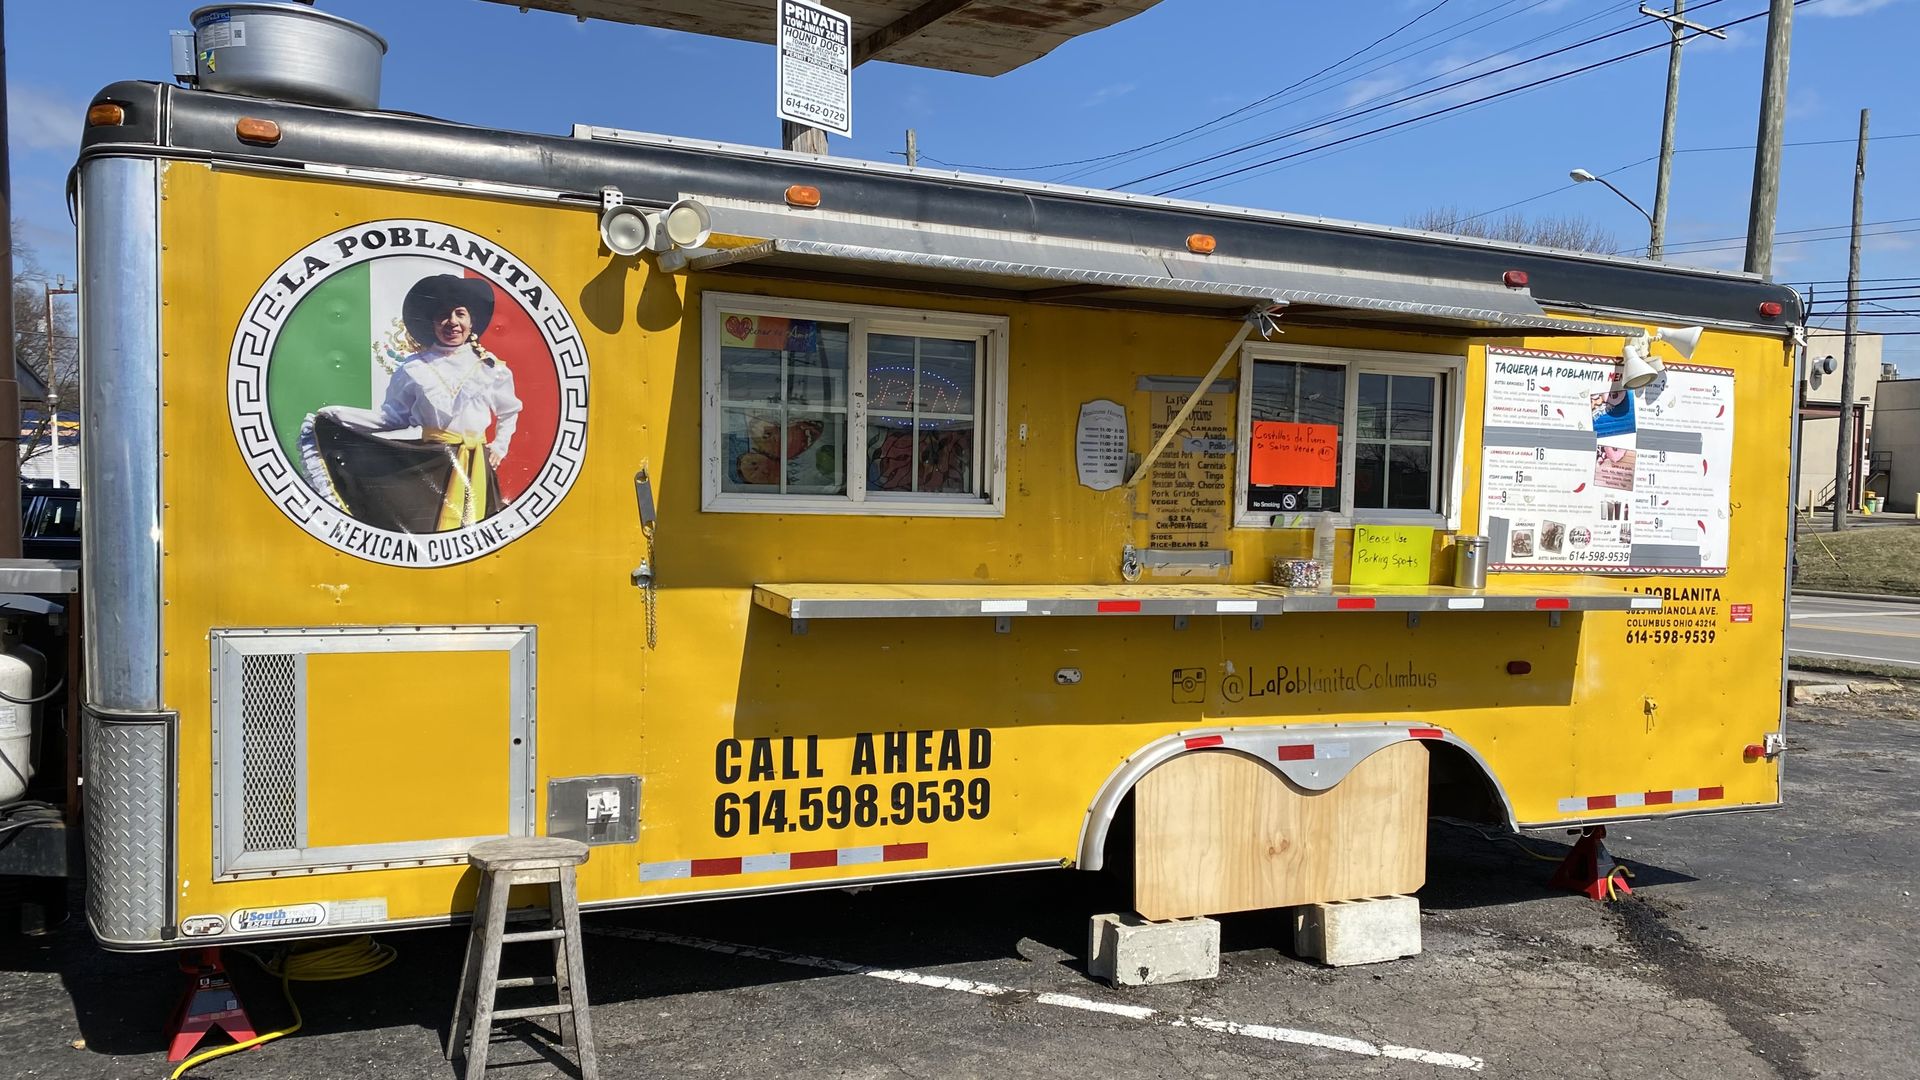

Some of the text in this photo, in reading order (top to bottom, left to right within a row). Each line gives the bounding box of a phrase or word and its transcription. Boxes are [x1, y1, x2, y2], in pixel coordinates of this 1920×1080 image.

[785, 2, 845, 35] PRIVATE
[785, 16, 845, 44] TOW-AWAY ZONE
[785, 26, 845, 55] HOUND DOG'S
[277, 227, 545, 311] LA POBLANITA
[1495, 362, 1538, 377] TAQUERIA
[1540, 366, 1553, 377] LA
[1556, 368, 1604, 382] POBLANITA
[1526, 378, 1536, 392] 15
[1166, 396, 1175, 404] La
[1540, 404, 1548, 416] 16
[1203, 432, 1226, 440] Asada
[1208, 441, 1226, 450] Pollo
[1204, 450, 1226, 458] Pastor
[1536, 448, 1544, 460] 16
[1659, 451, 1666, 463] 13
[1205, 471, 1224, 482] Tinga
[1515, 471, 1524, 484] 15
[1648, 473, 1655, 485] 11
[1198, 481, 1225, 489] Chorizo
[1502, 491, 1507, 503] 9
[1650, 495, 1657, 506] 11
[1261, 501, 1280, 509] Smoking
[1654, 517, 1659, 529] 9
[328, 519, 508, 562] MEXICAN CUISINE
[1358, 528, 1408, 544] Please Use
[1392, 554, 1418, 568] Spots
[1569, 550, 1629, 562] 614-598-9539
[1648, 606, 1697, 615] INDIANOLA
[1699, 607, 1718, 615] AVE.
[1626, 619, 1671, 628] COLUMBUS
[1673, 619, 1693, 627] OHIO
[1626, 630, 1716, 644] 614-598-9539
[714, 728, 992, 785] CALL AHEAD
[714, 778, 990, 838] 614.598.9539
